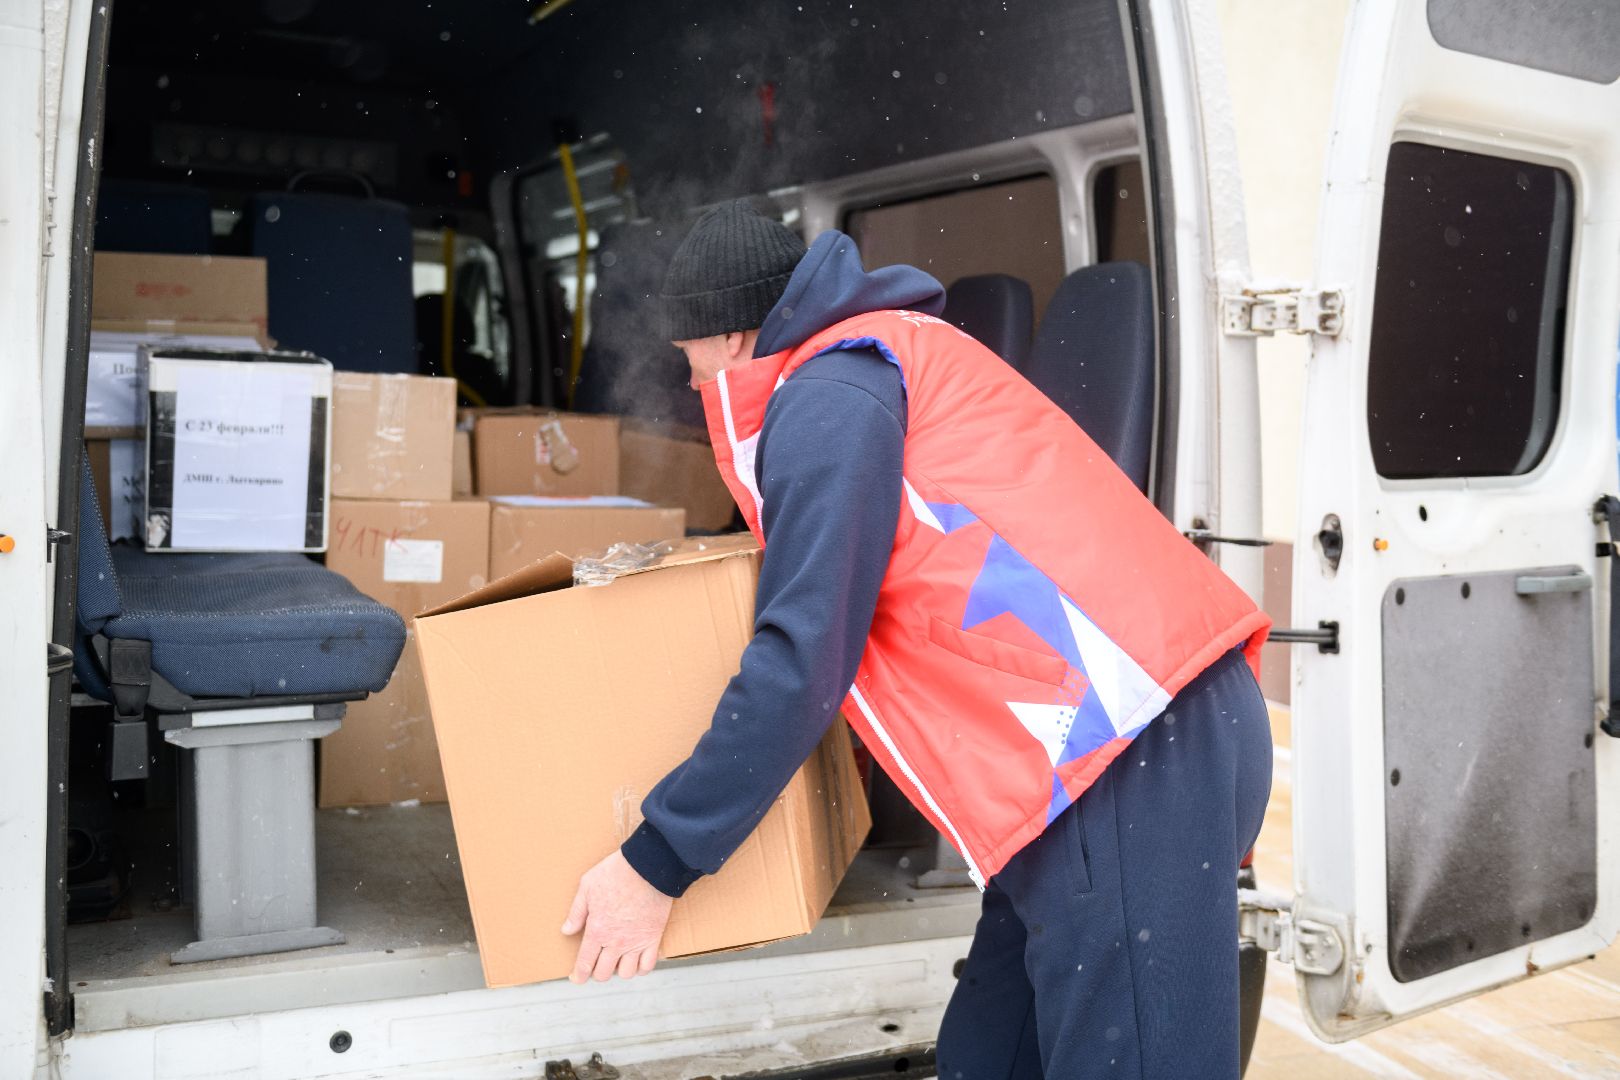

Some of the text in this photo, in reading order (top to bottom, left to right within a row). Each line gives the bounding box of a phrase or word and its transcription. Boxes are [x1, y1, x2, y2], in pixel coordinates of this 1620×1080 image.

[185, 419, 284, 436] С 23 февраля!!!
